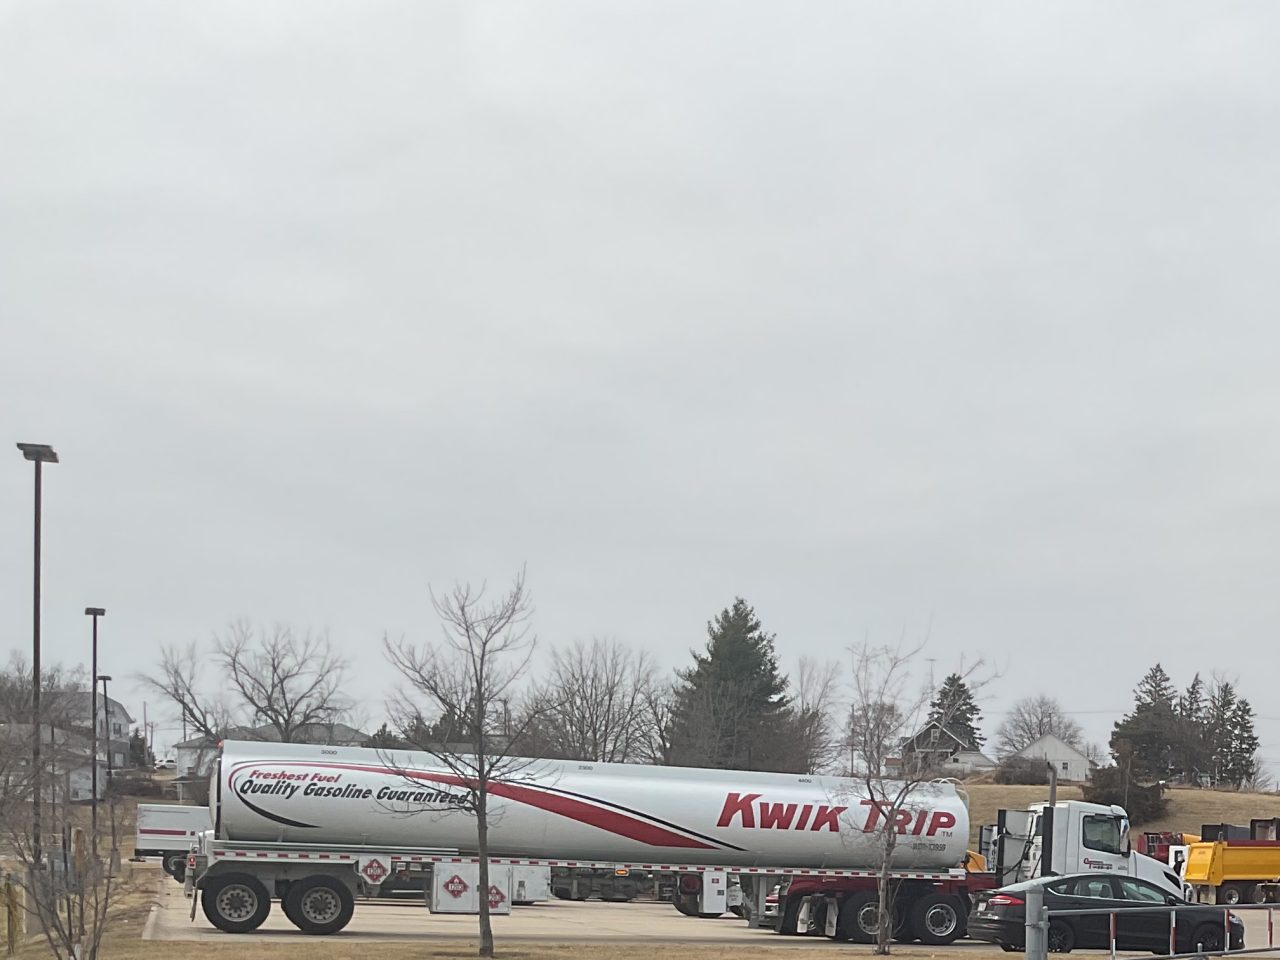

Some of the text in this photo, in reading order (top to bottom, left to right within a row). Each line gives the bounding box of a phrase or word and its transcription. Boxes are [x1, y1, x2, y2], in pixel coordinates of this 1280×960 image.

[249, 770, 342, 783] Freshest Fuel
[240, 779, 472, 804] Quality Gasoline Guaranteed
[717, 792, 956, 837] KWIK TRIP
